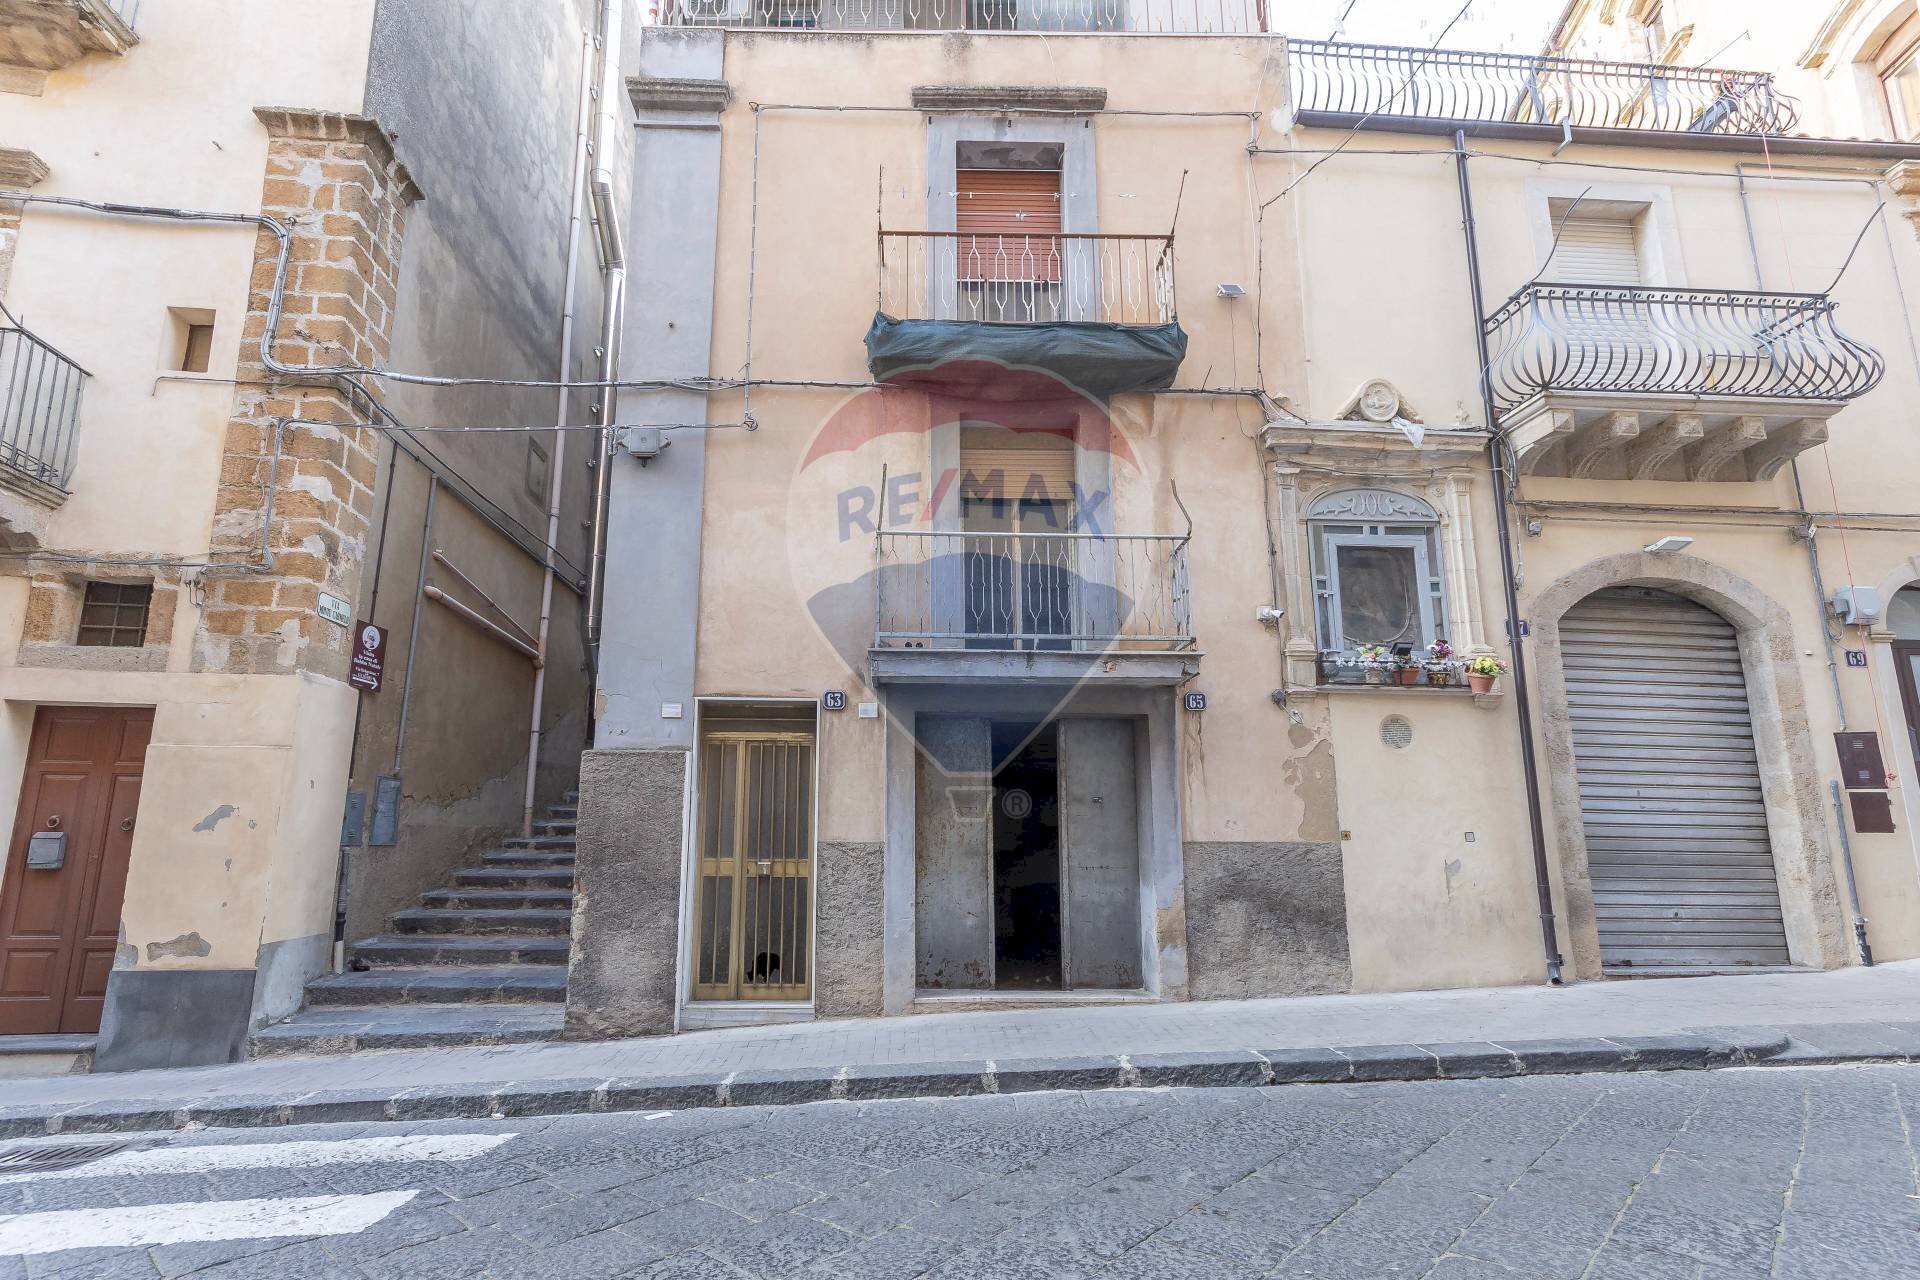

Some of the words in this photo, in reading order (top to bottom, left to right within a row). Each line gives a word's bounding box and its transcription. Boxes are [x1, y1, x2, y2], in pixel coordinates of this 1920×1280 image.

[331, 599, 340, 610] VIA
[1849, 652, 1865, 666] 69
[827, 693, 841, 707] 63
[1190, 695, 1203, 708] 65
